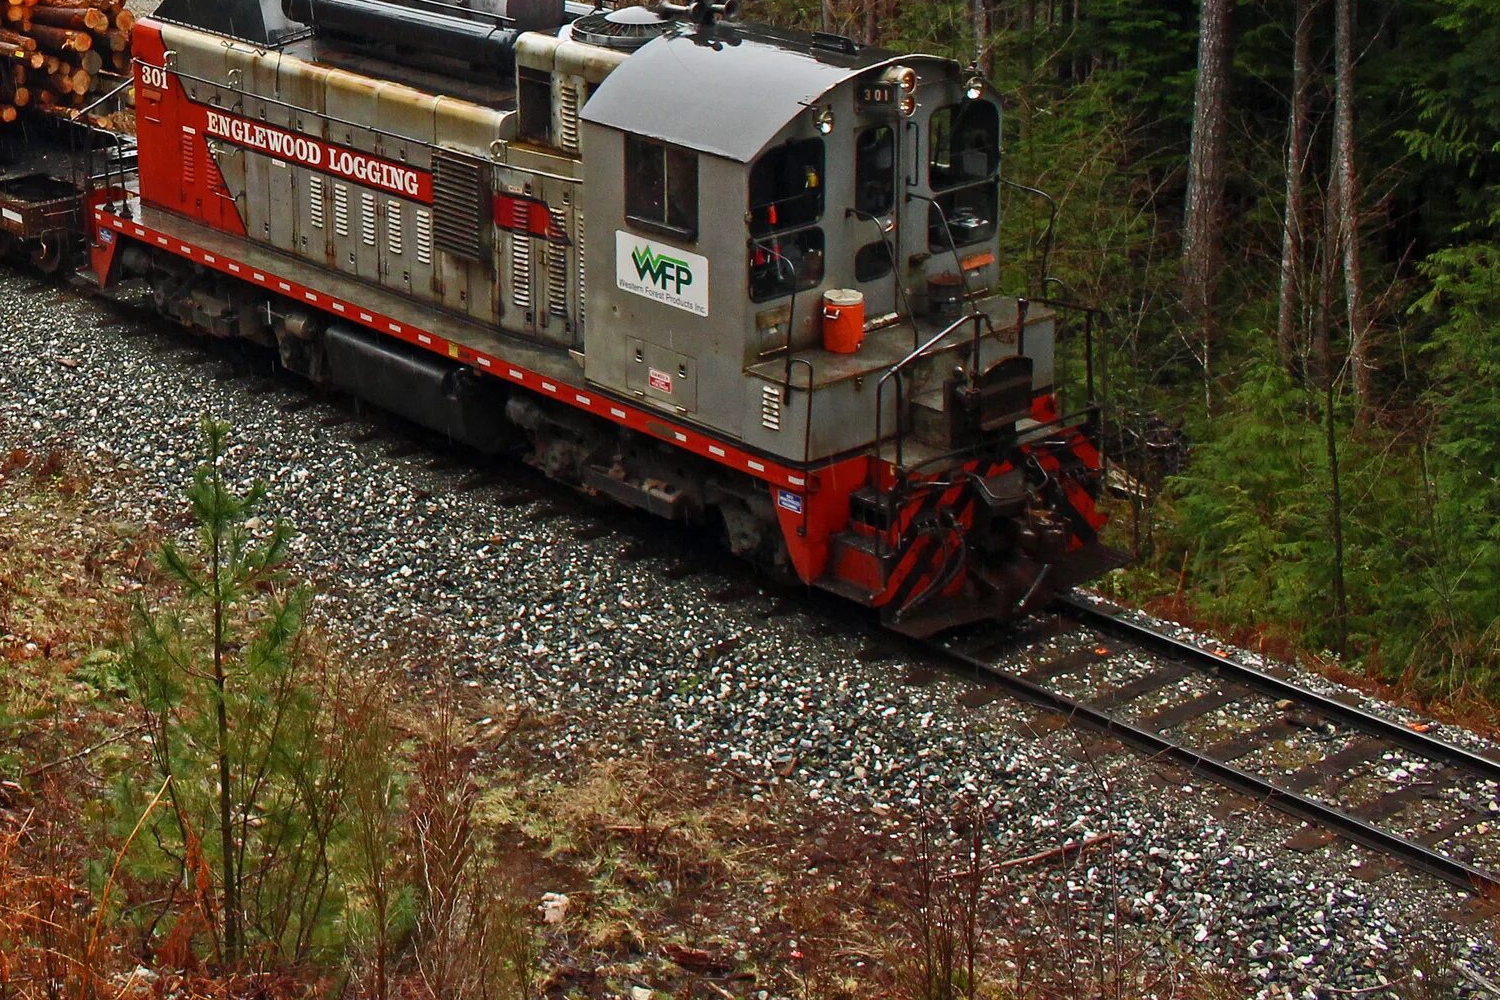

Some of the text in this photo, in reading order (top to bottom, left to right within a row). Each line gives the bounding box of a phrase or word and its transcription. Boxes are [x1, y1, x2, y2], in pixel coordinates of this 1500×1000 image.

[142, 65, 169, 90] 301
[864, 89, 888, 102] 301
[206, 111, 419, 195] ENGLEWOOD LOGGING
[631, 246, 693, 296] WFP
[619, 279, 644, 292] Western
[645, 286, 665, 299] Forest
[665, 293, 694, 310] Products
